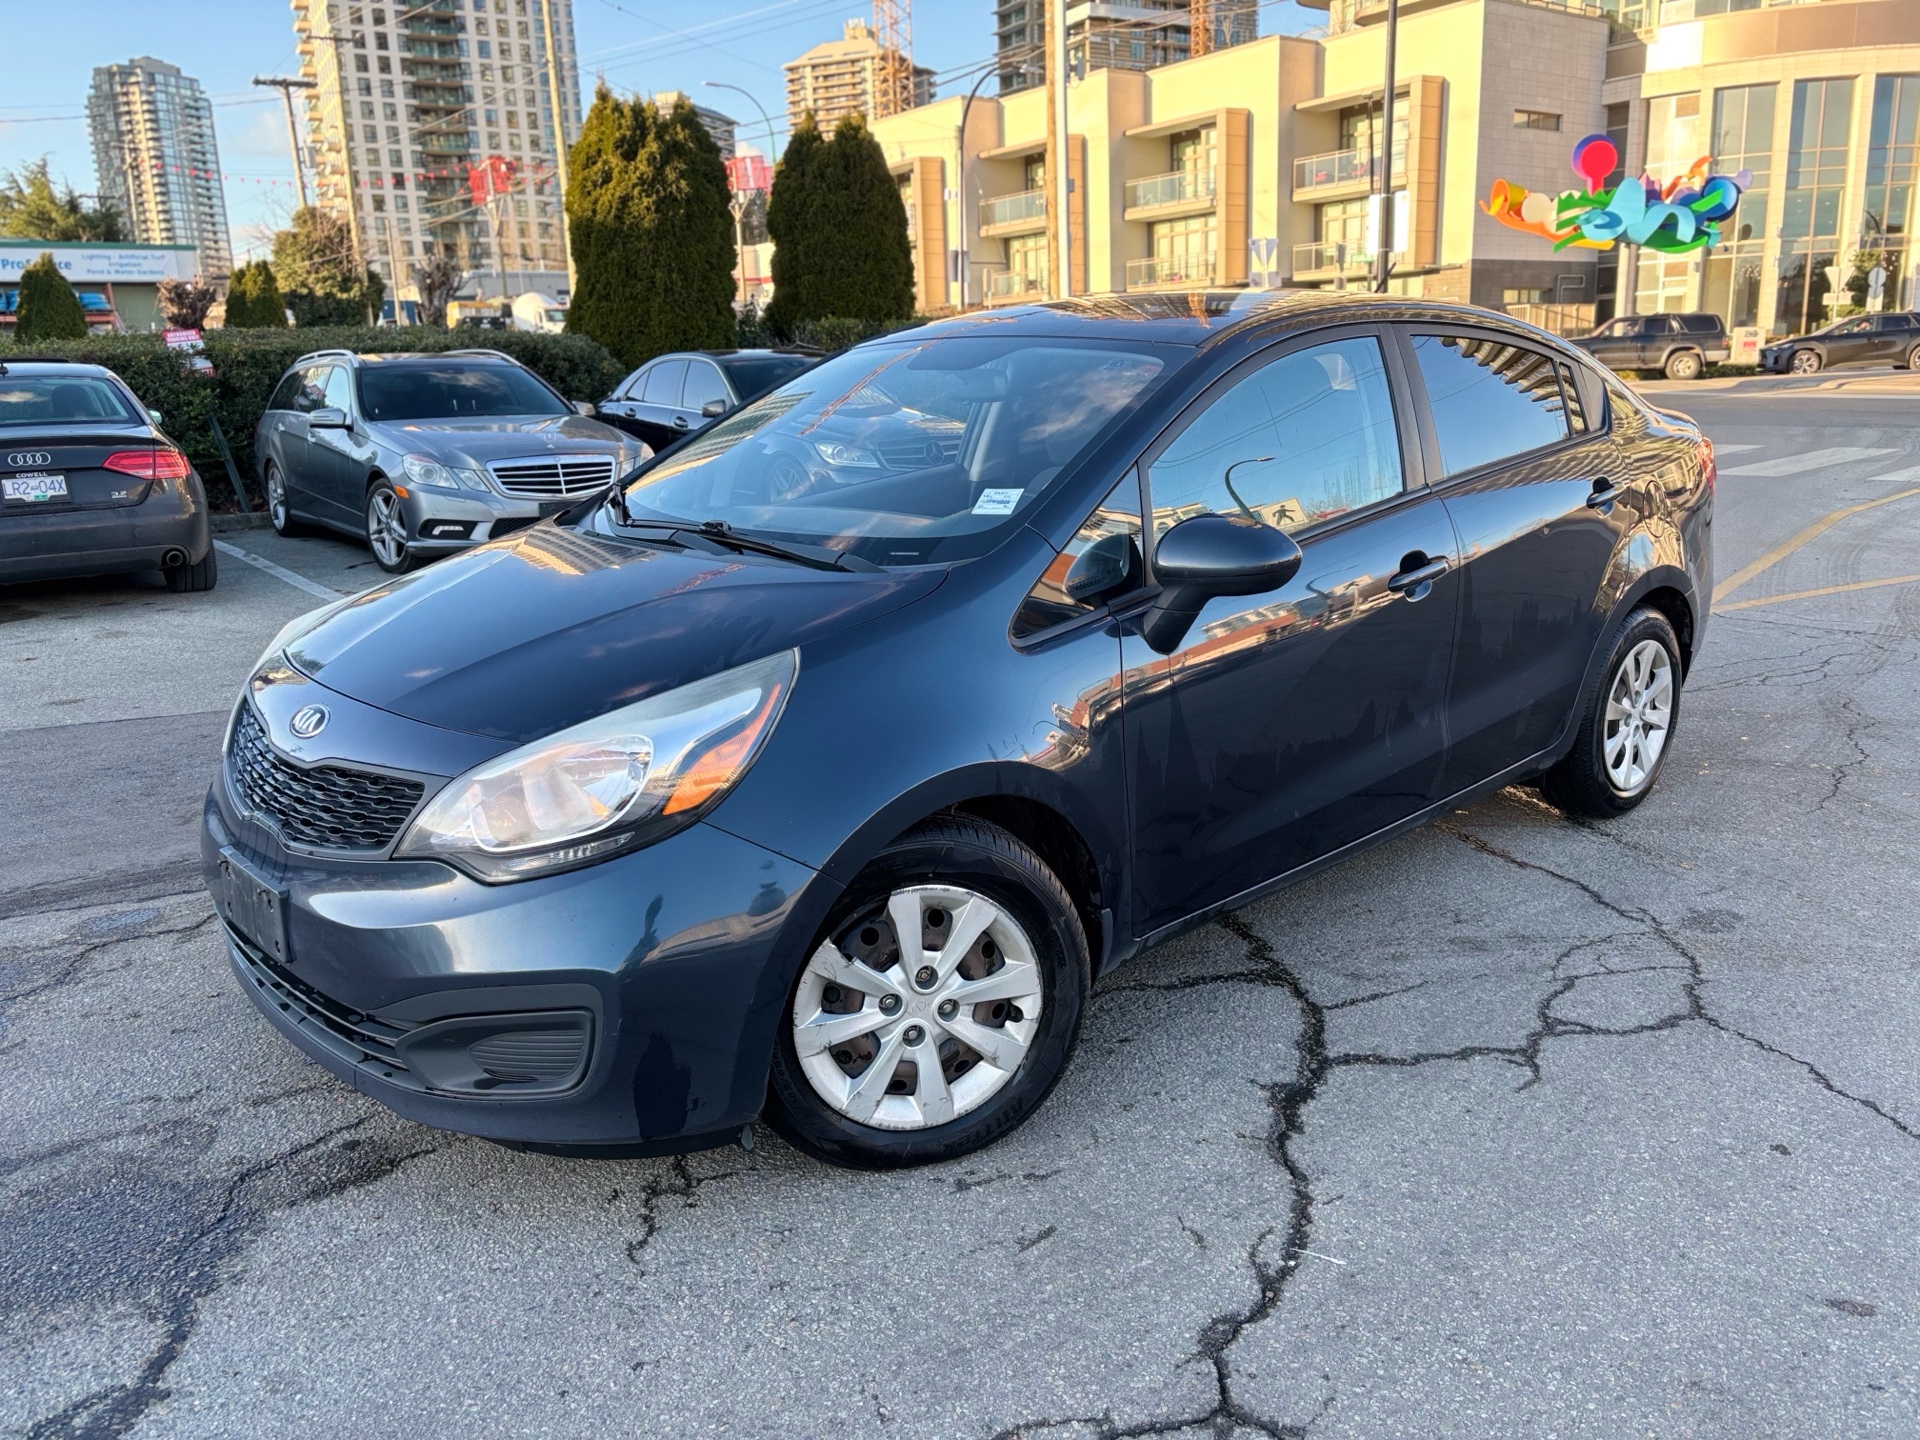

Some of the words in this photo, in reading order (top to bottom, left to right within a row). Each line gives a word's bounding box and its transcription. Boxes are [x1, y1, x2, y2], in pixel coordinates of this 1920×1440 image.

[82, 253, 111, 261] Lighting
[2, 481, 31, 497] LR2
[39, 478, 66, 494] 04X
